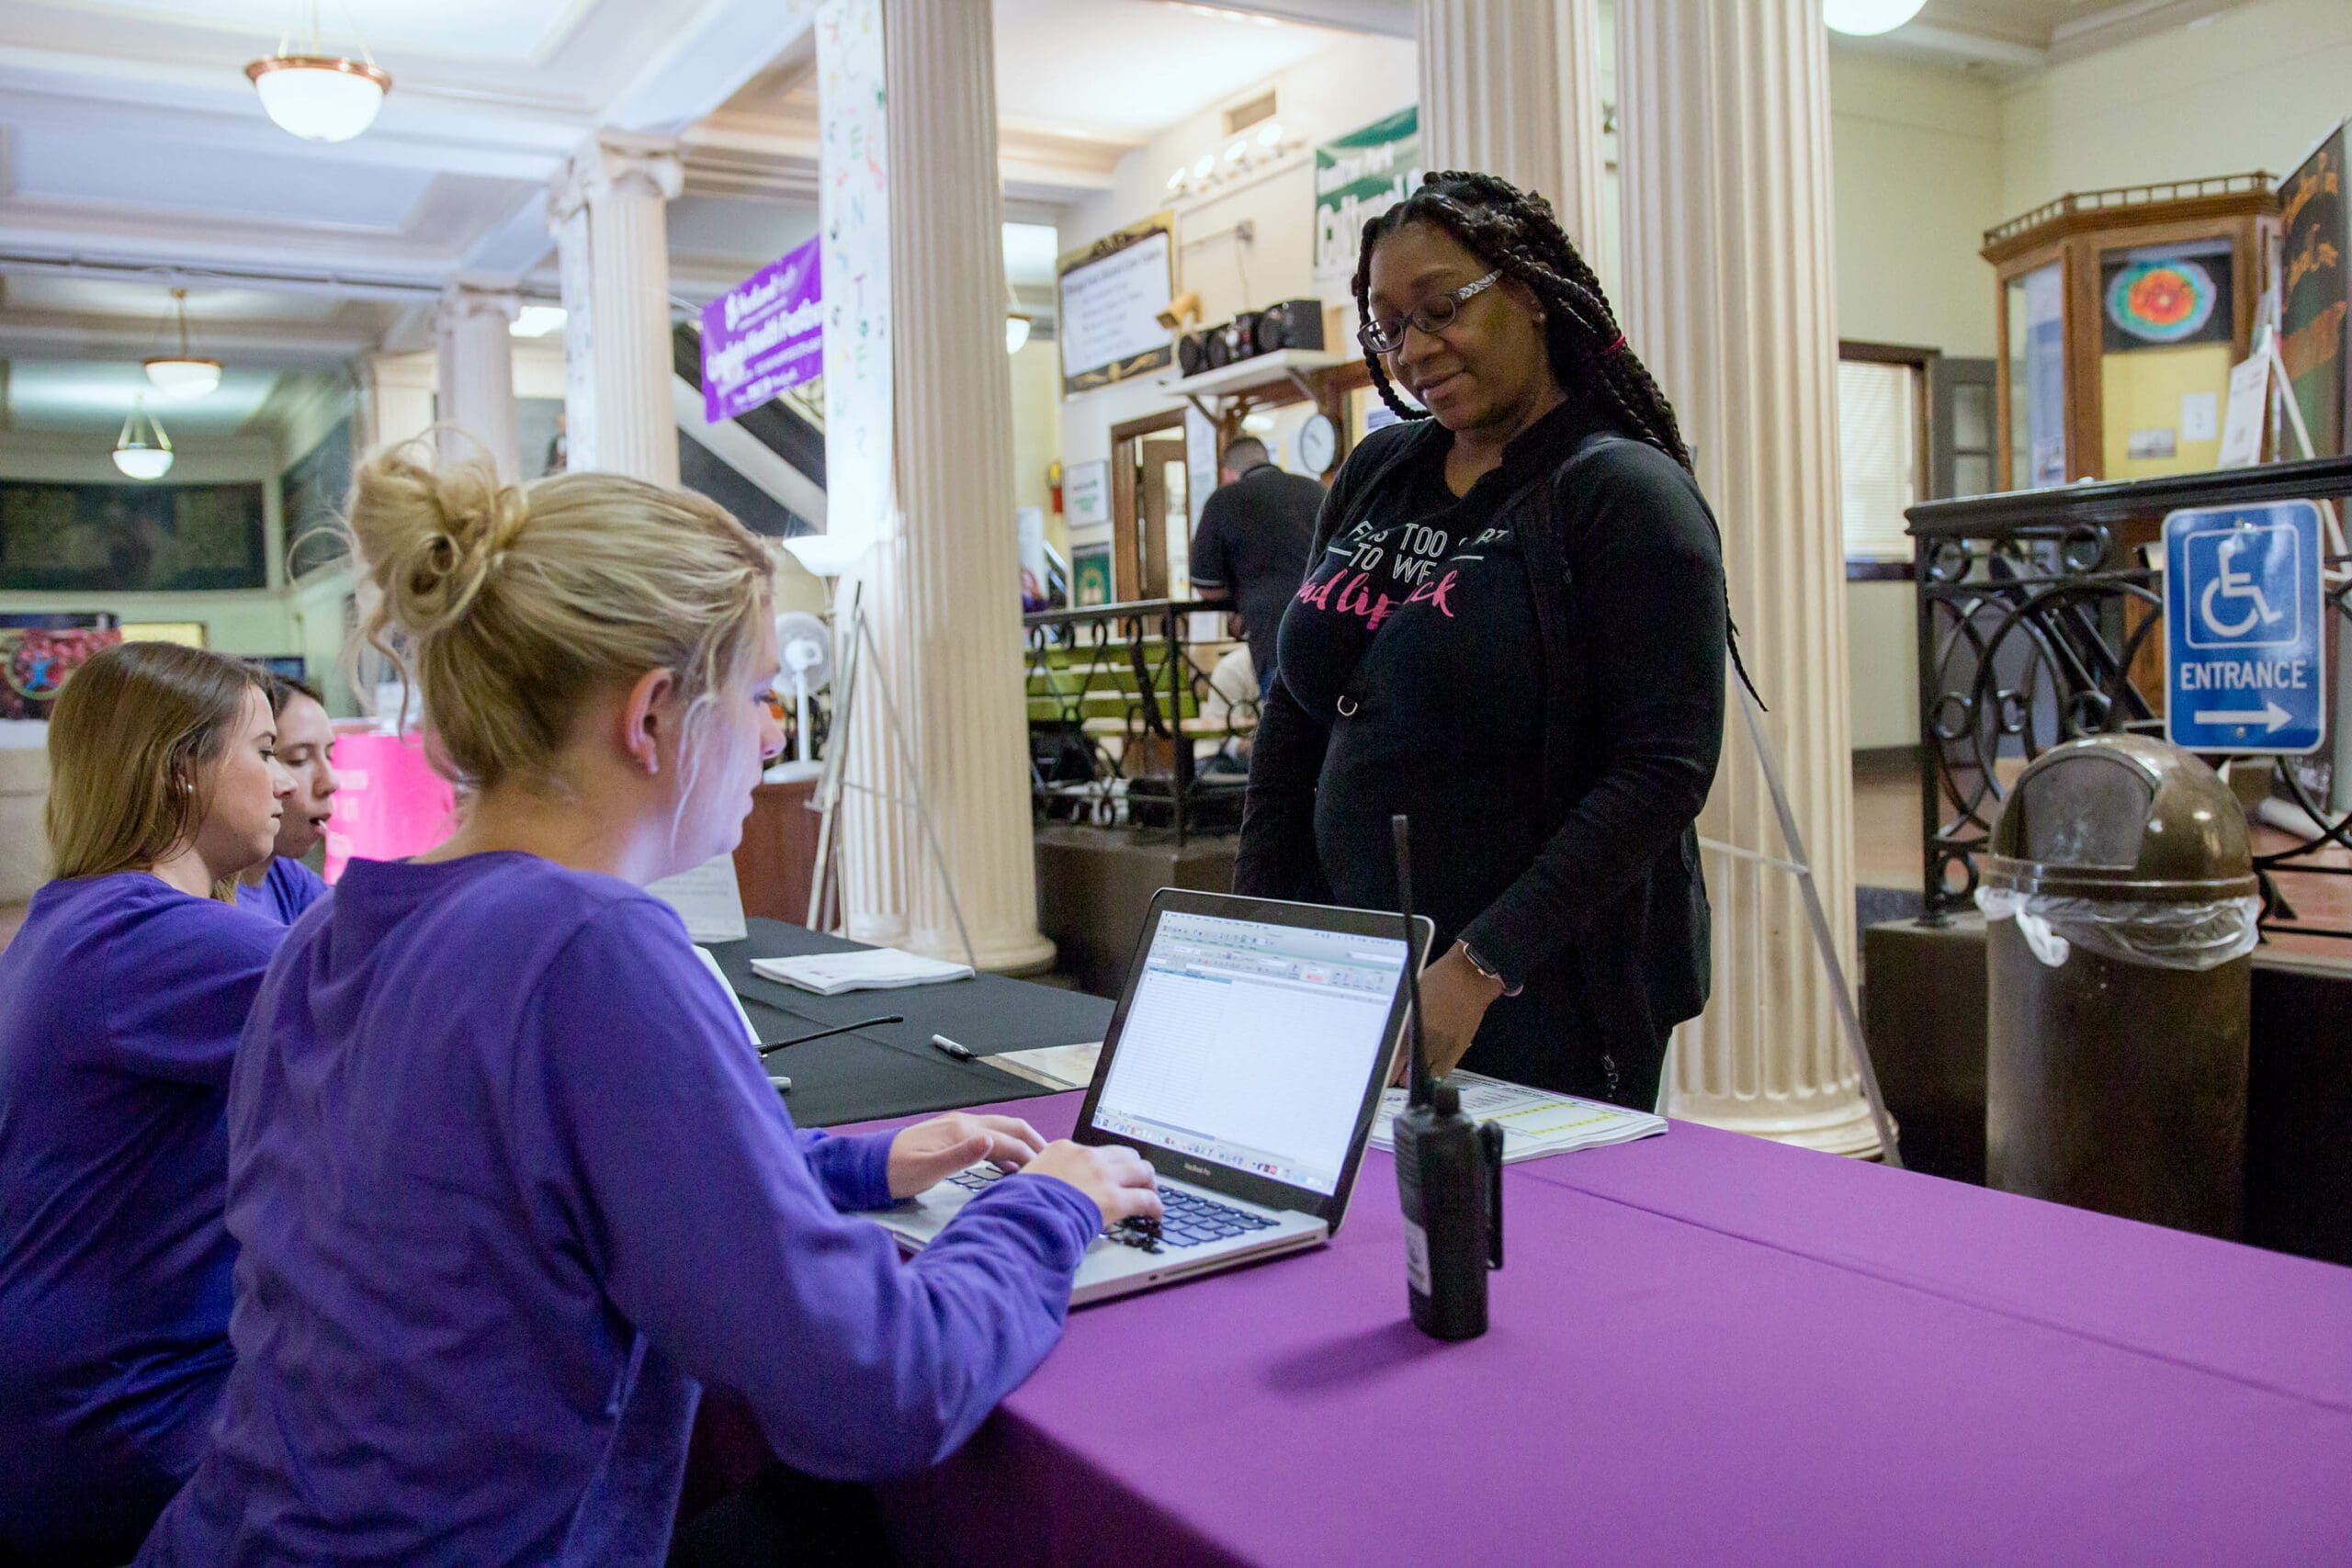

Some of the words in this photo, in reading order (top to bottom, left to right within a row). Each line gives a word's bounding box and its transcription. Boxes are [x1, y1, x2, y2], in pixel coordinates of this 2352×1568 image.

[1399, 522, 1448, 558] TOO
[1348, 542, 1384, 570] TO
[2180, 660, 2308, 690] ENTRANCE
